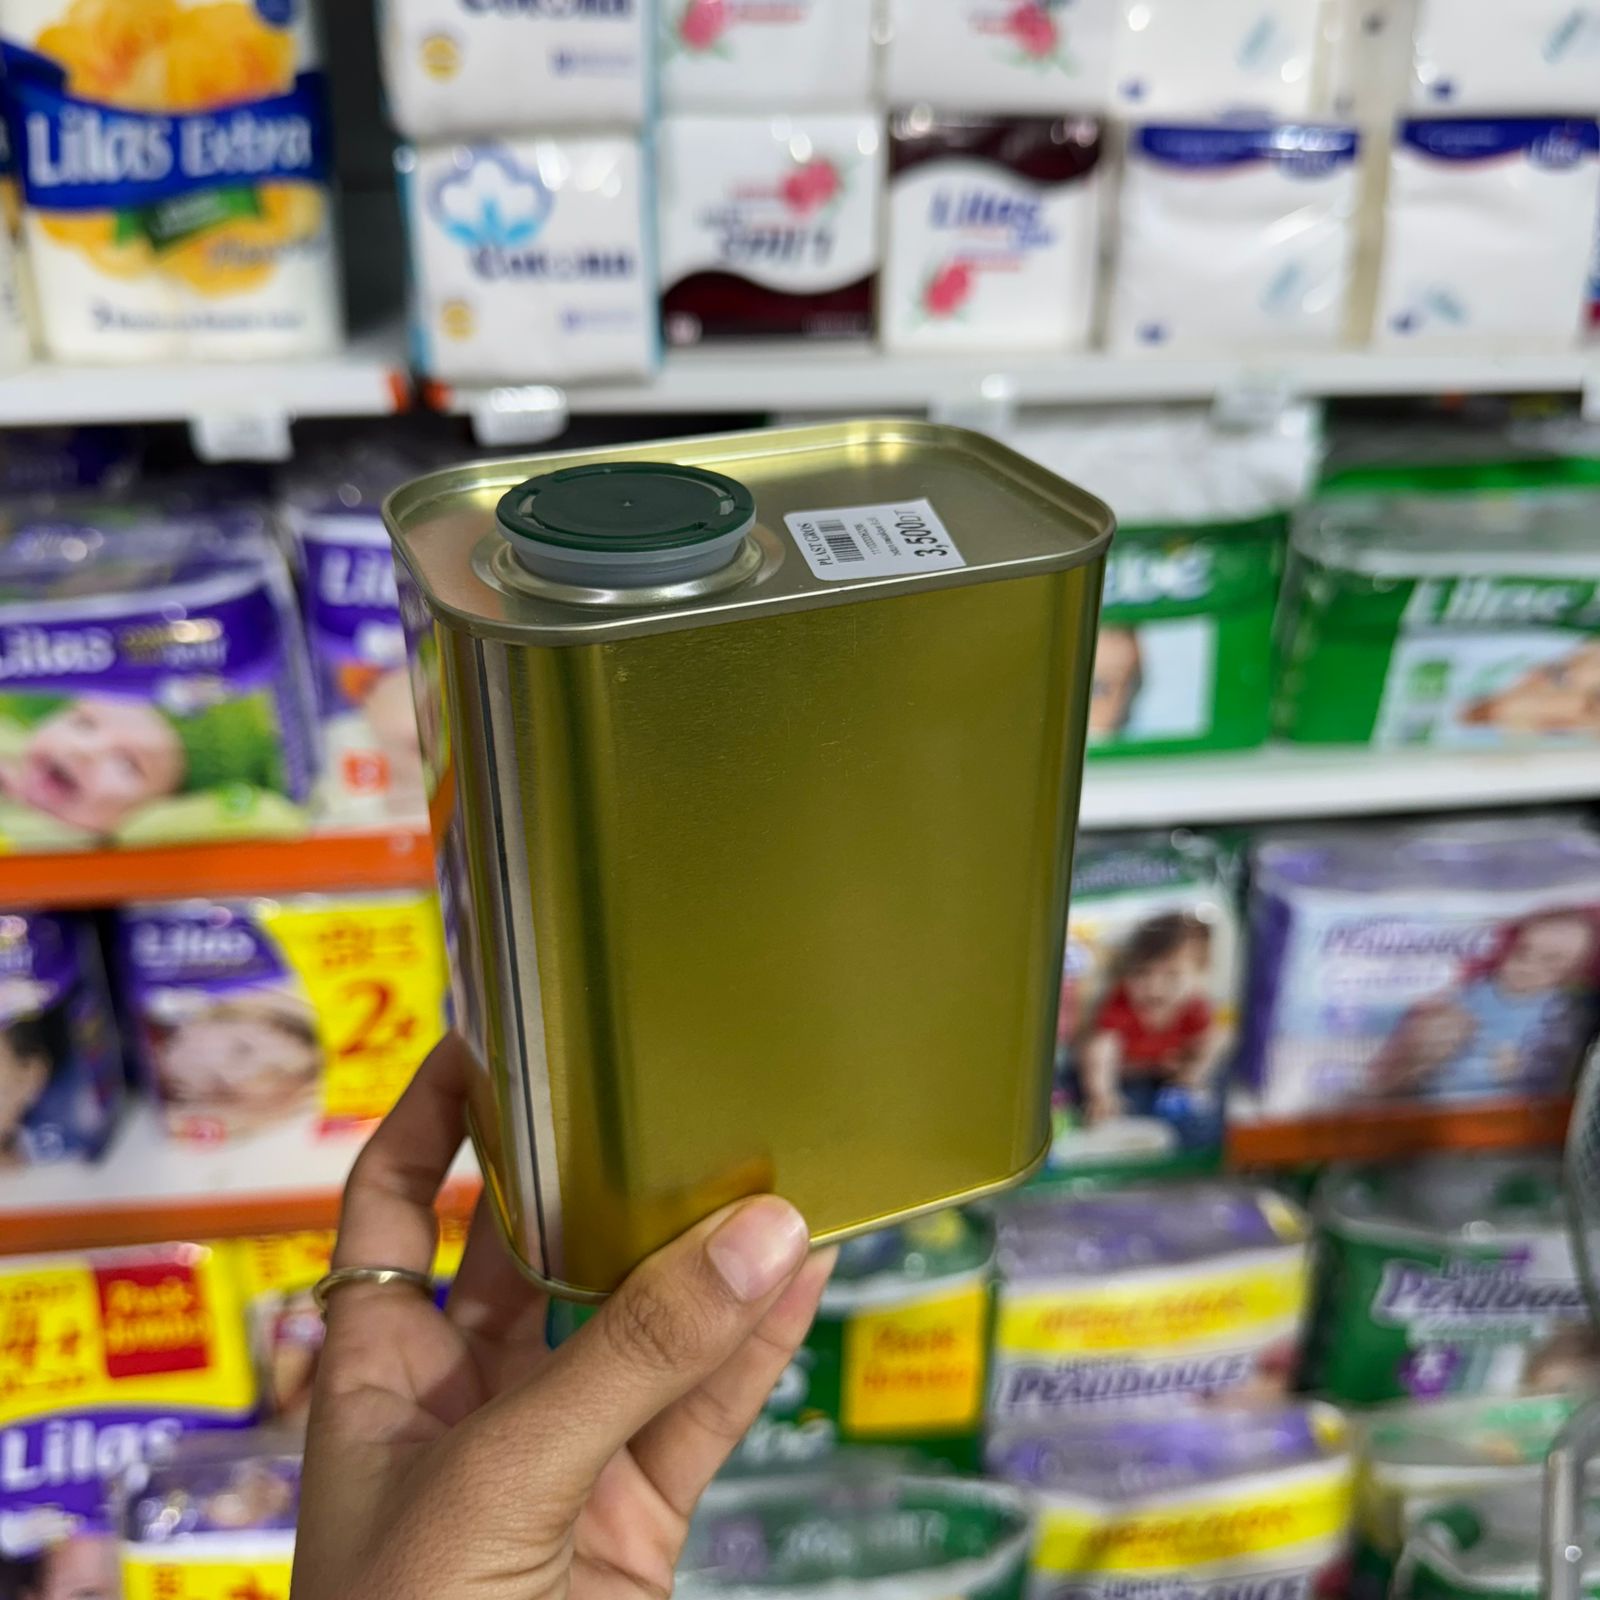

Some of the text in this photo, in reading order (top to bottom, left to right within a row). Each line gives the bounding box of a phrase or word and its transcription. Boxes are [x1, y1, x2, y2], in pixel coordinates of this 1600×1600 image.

[27, 110, 174, 188] Lilas
[796, 522, 834, 566] PLAST GROS
[1, 1419, 184, 1492] Lilas
